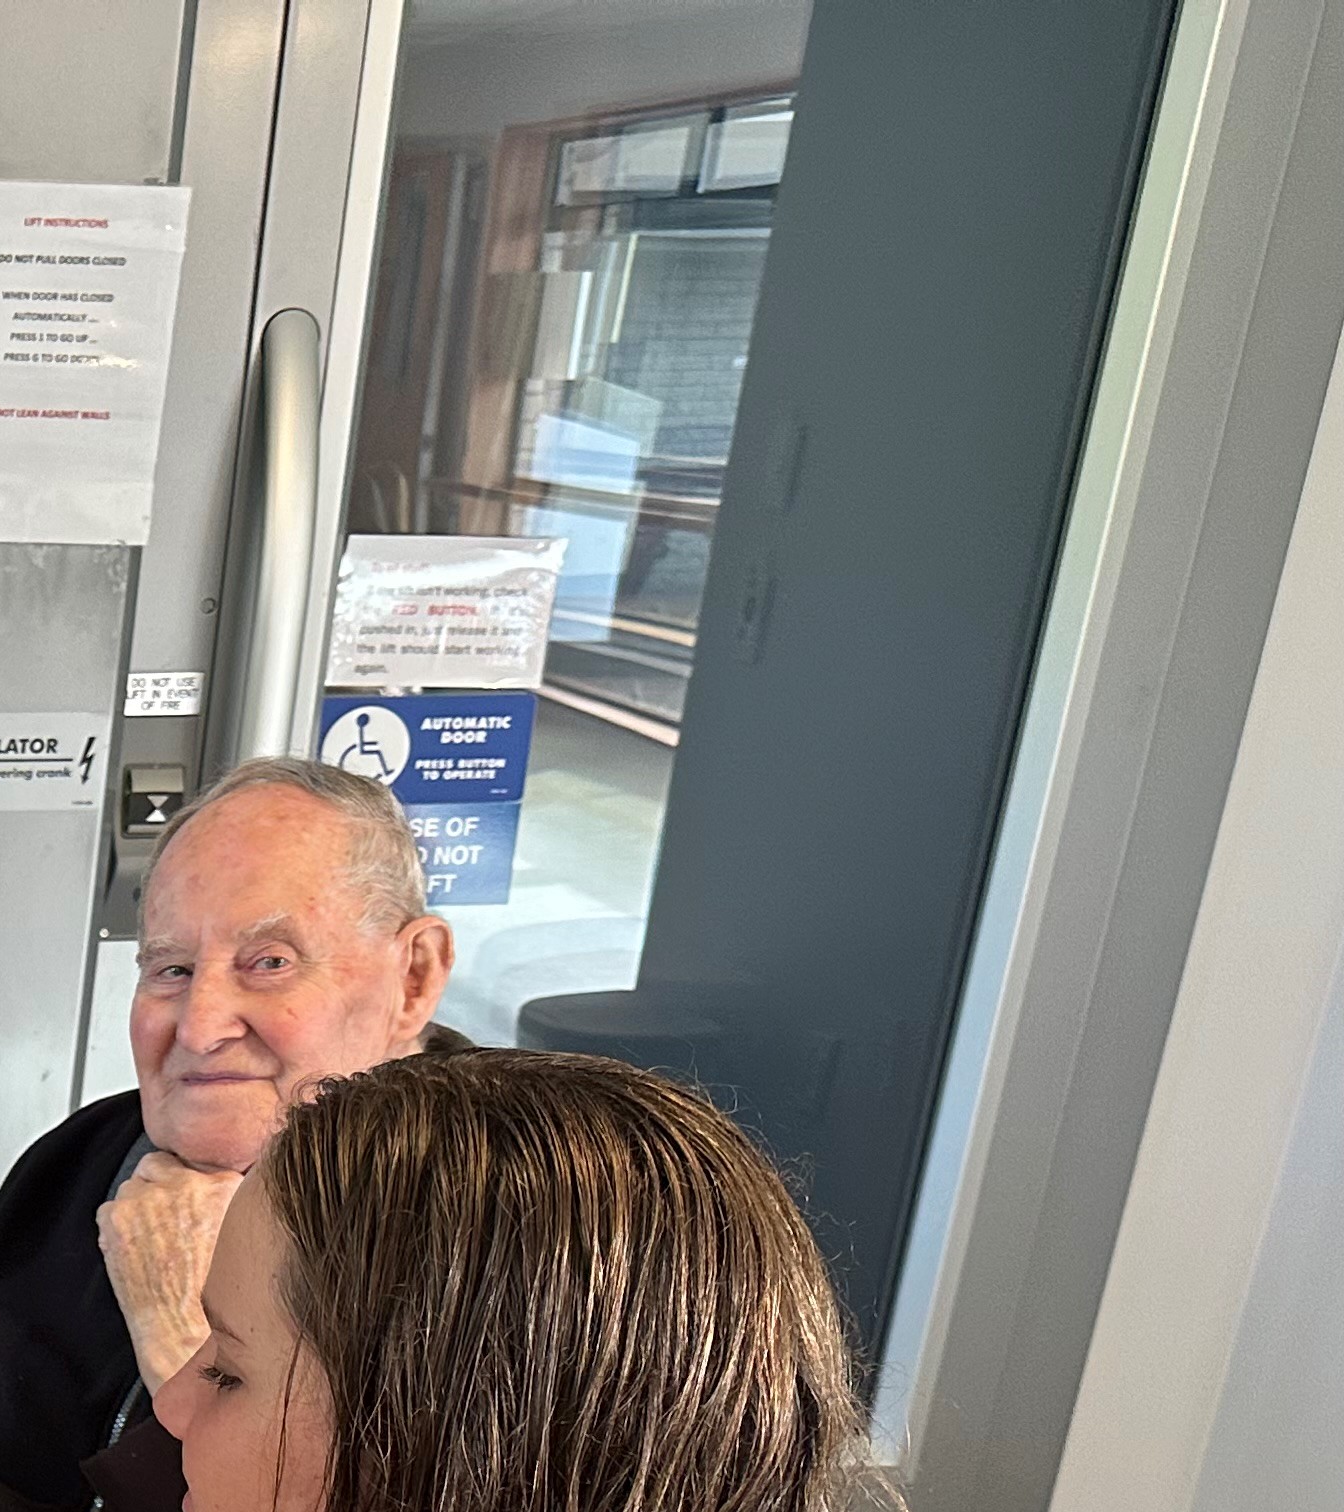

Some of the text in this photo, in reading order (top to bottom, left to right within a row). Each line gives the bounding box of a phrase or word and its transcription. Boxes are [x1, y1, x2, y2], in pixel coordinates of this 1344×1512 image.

[23, 217, 109, 229] LIFT INSTRUCTIONS
[14, 254, 34, 264] NOT
[35, 254, 57, 265] PULL
[58, 255, 91, 265] DOORS
[92, 256, 127, 266] CLOSED
[1, 291, 114, 303] WHEN DOOR HAS CLOSED
[9, 332, 37, 342] PRESS
[46, 332, 59, 343] TO
[3, 352, 31, 362] PRESS
[41, 353, 54, 363] TO
[40, 409, 80, 419] AGAINST
[399, 643, 440, 655] should
[131, 677, 197, 688] DO NOT USE
[152, 689, 161, 699] IN
[167, 688, 200, 699] EVENT
[140, 699, 181, 711] OF FIRE
[420, 716, 513, 730] AUTOMATIC
[440, 730, 487, 744] DOOR
[415, 758, 506, 770] PRESS BUTTON
[35, 768, 72, 779] crank
[422, 769, 496, 781] TO OPERATE
[445, 816, 481, 838] OF
[432, 845, 485, 866] NOT
